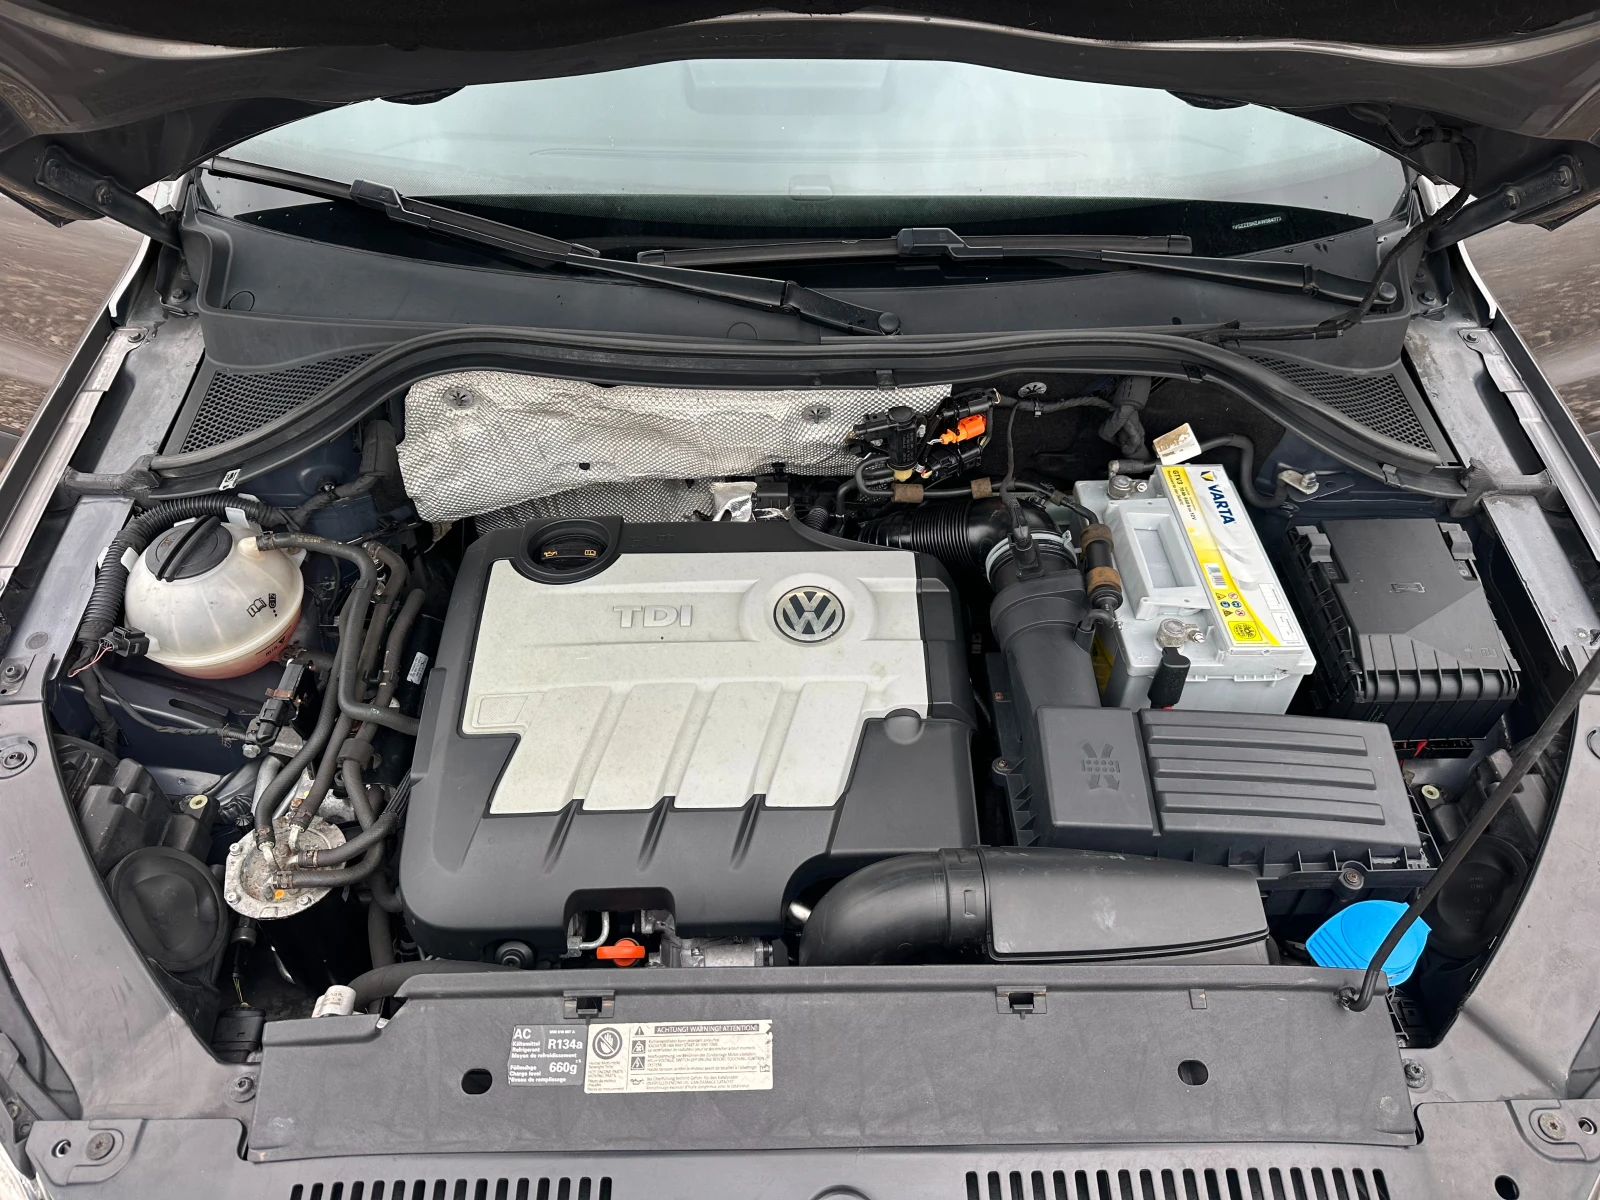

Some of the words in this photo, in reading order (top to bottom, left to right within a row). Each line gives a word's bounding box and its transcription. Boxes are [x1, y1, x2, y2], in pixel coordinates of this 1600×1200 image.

[1208, 484, 1236, 524] VARTA
[613, 605, 693, 628] TDI
[514, 1028, 532, 1040] AC
[548, 1038, 583, 1050] R134a
[548, 1062, 578, 1074] 660g
